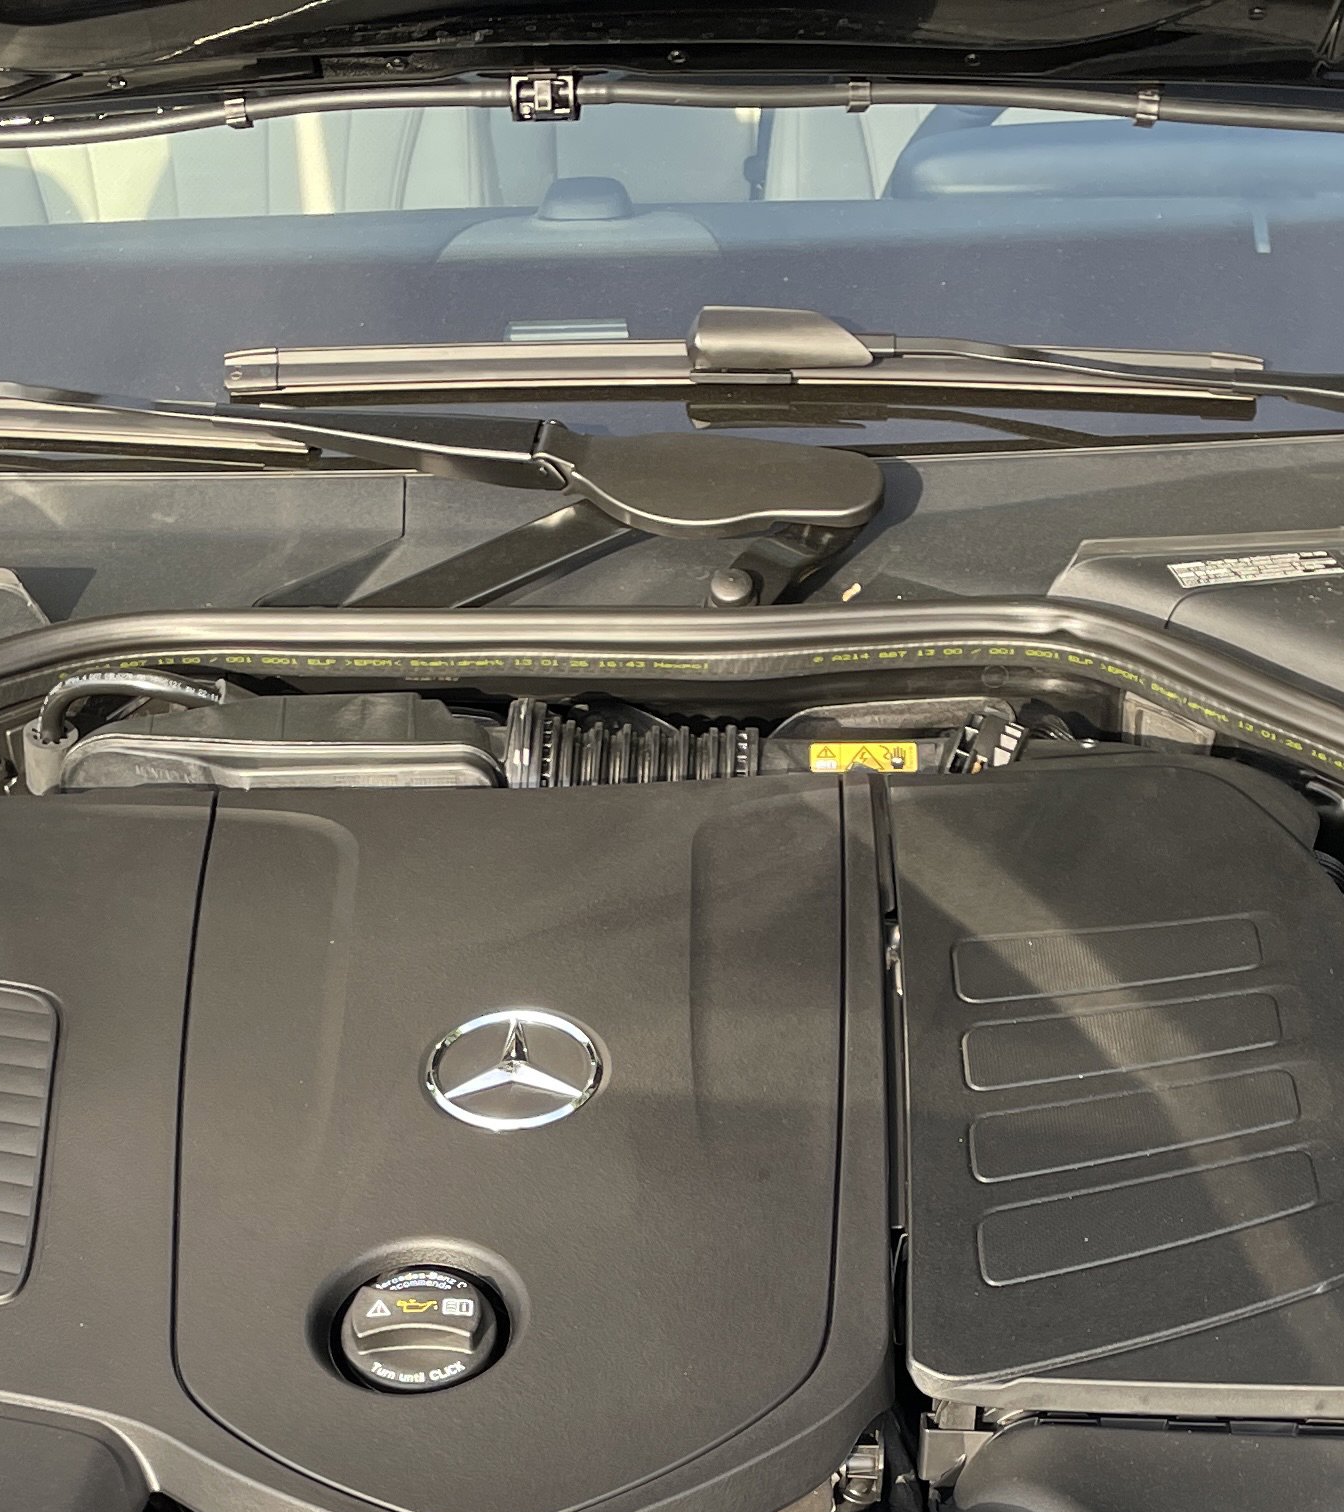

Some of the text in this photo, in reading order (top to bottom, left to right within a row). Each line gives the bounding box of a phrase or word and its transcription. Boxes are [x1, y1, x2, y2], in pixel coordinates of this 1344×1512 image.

[390, 1279, 452, 1291] ecommends
[370, 1360, 466, 1383] Turn until CLICK
